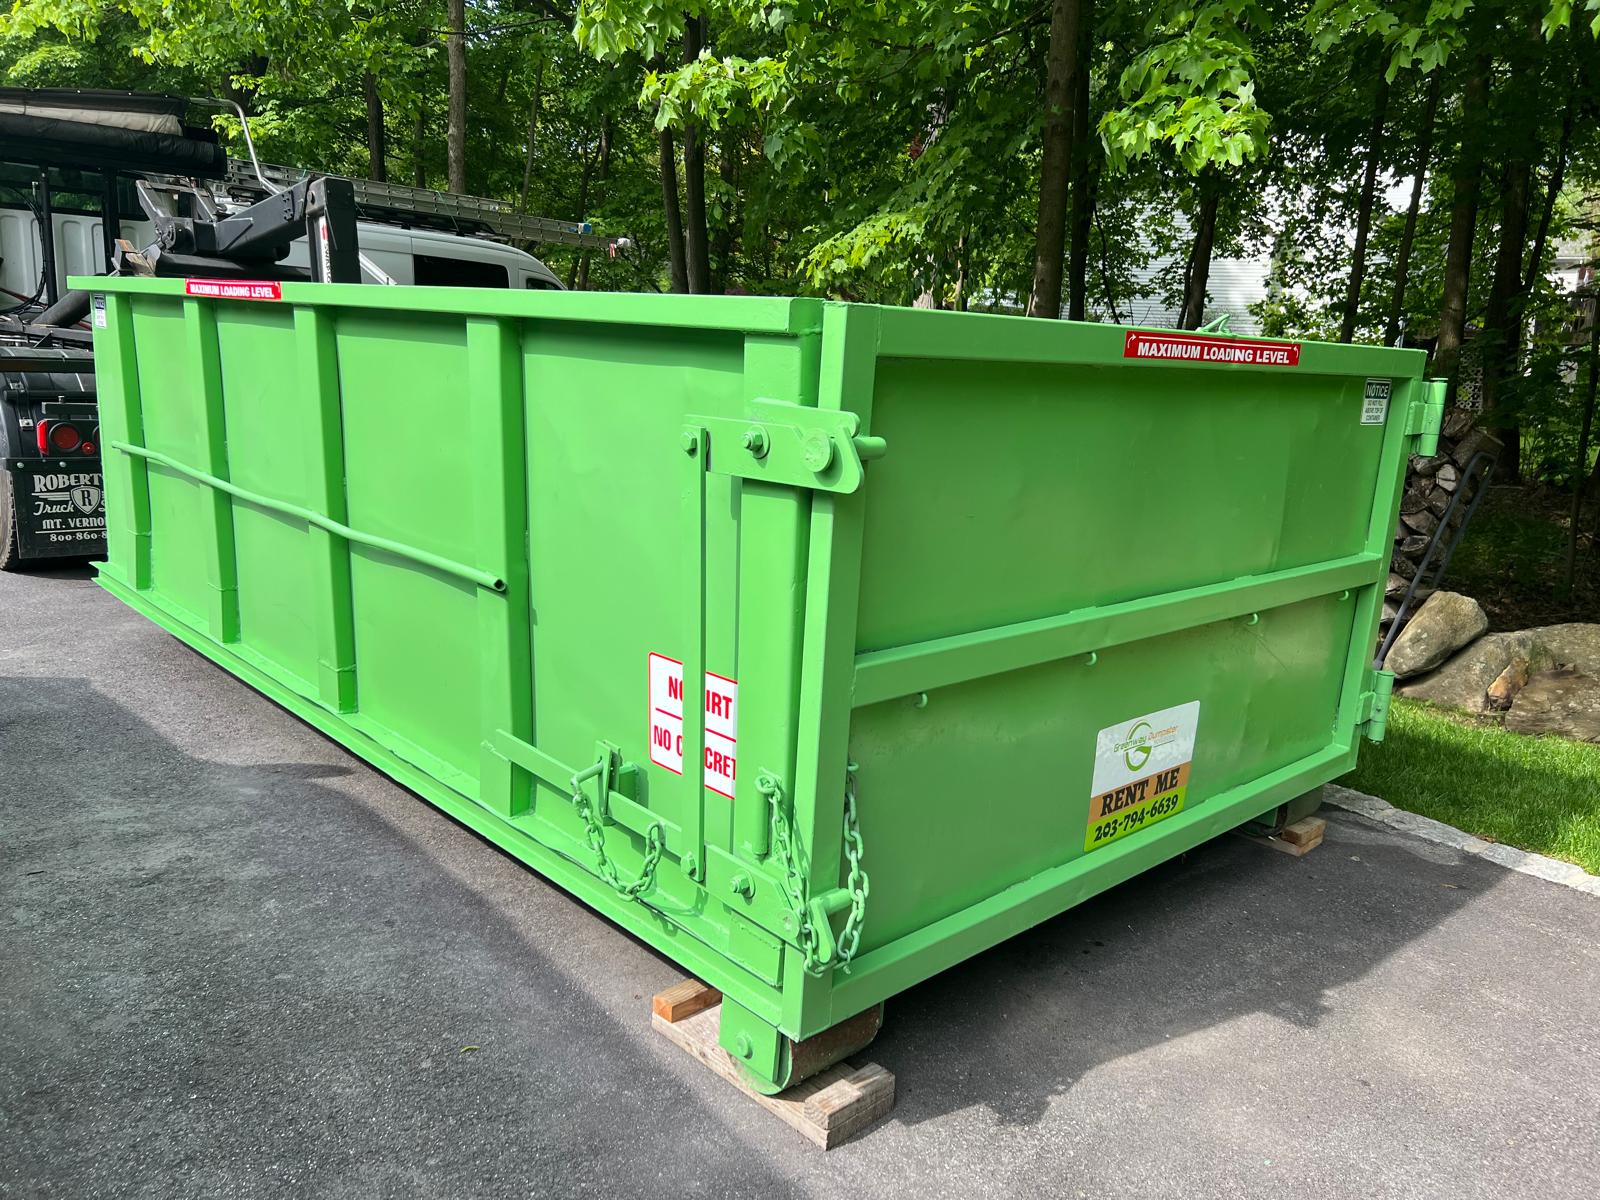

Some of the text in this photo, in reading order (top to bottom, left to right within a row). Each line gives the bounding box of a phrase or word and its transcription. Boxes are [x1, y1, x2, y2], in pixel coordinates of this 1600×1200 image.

[190, 284, 275, 298] MAXIMUM LOADING LEVEL
[1137, 341, 1290, 364] MAXIMUM LOADING LEVEL
[1366, 384, 1389, 397] NOTICE
[33, 473, 105, 492] ROBERT
[81, 489, 93, 507] R
[33, 500, 74, 516] Truck
[42, 516, 105, 530] MT. VERNO
[653, 724, 672, 751] NO
[1113, 735, 1147, 753] Greenway
[1100, 767, 1181, 817] RENT ME
[1094, 794, 1179, 842] 203-794-6639
